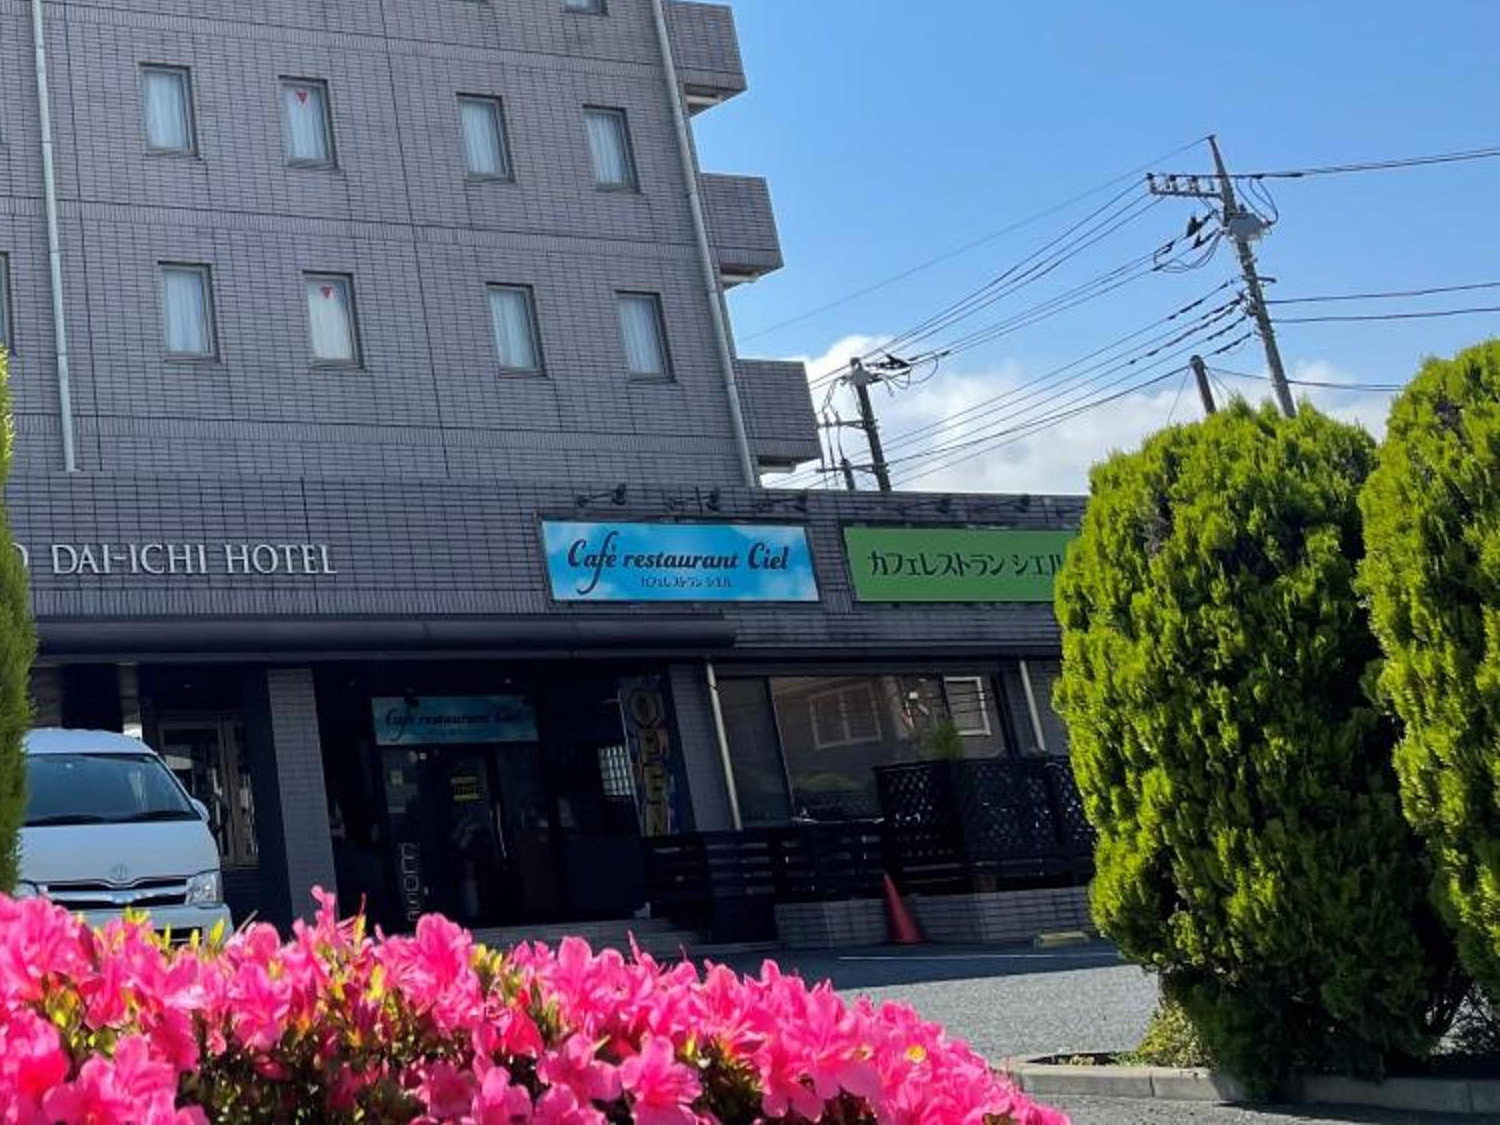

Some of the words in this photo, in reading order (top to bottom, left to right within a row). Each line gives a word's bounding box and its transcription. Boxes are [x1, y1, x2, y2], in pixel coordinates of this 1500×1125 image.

[51, 543, 208, 574] DAI-ICHI
[224, 543, 337, 574] HOTEL
[622, 550, 739, 569] restaurant
[748, 542, 789, 570] Ciel
[867, 551, 1004, 576] カフェレストラン
